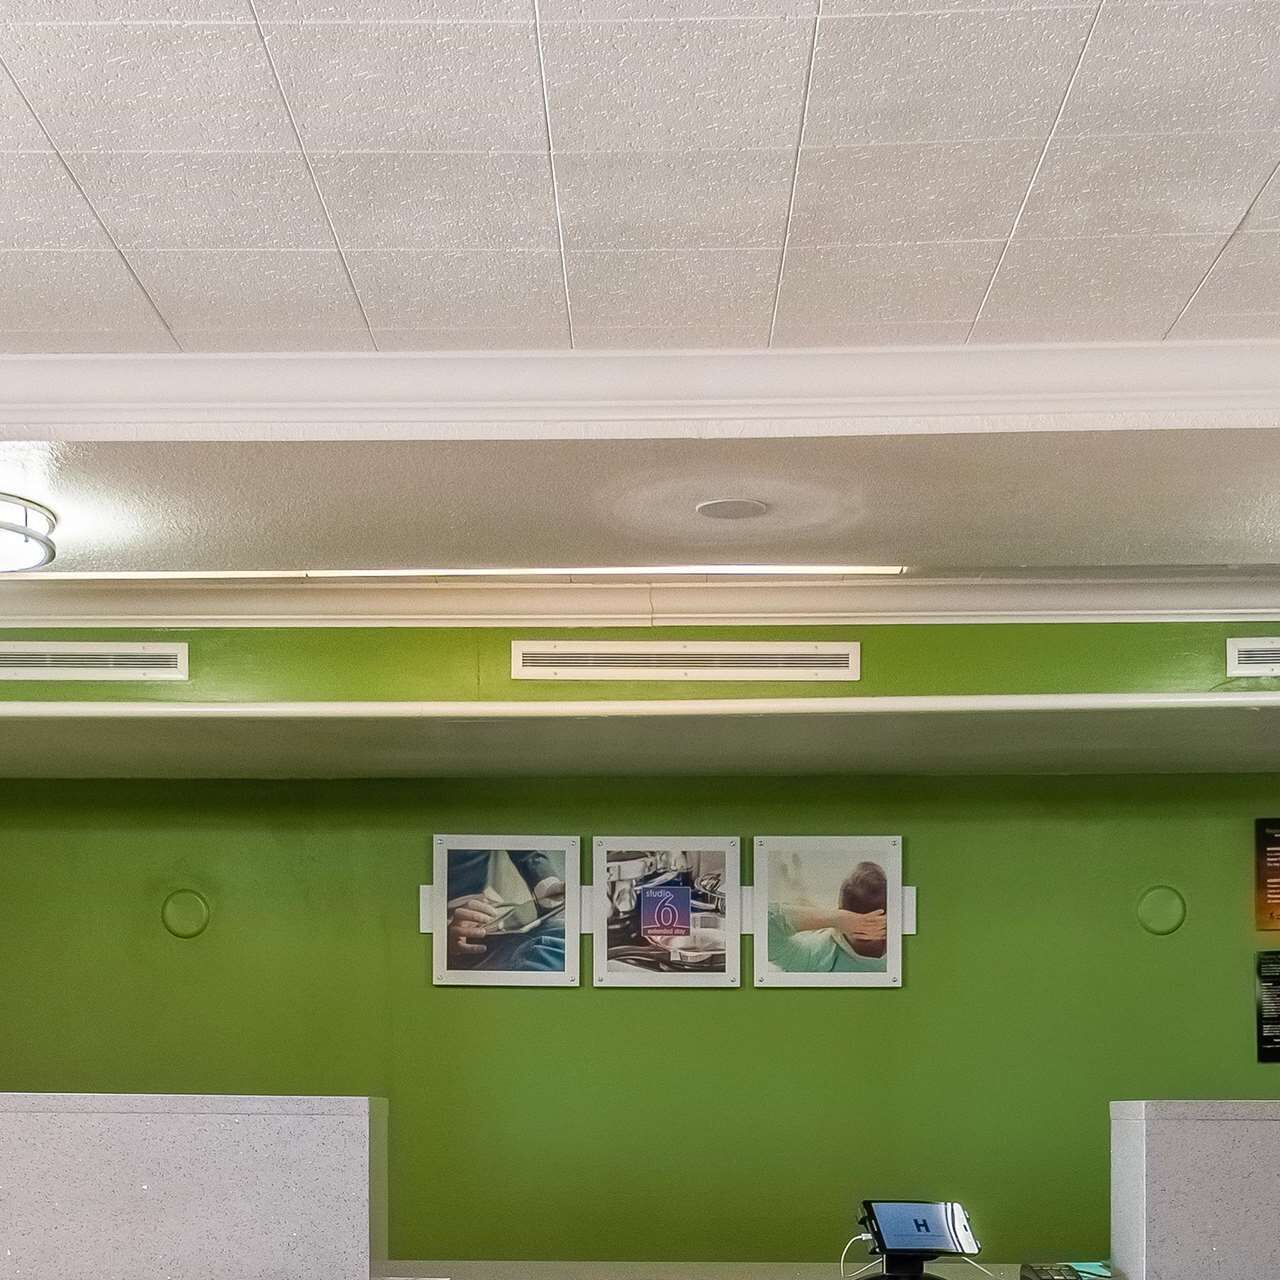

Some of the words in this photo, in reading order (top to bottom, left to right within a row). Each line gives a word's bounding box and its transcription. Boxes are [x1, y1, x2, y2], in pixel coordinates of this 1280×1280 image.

[645, 889, 671, 898] studio
[655, 895, 679, 928] 6
[913, 1218, 931, 1233] H
